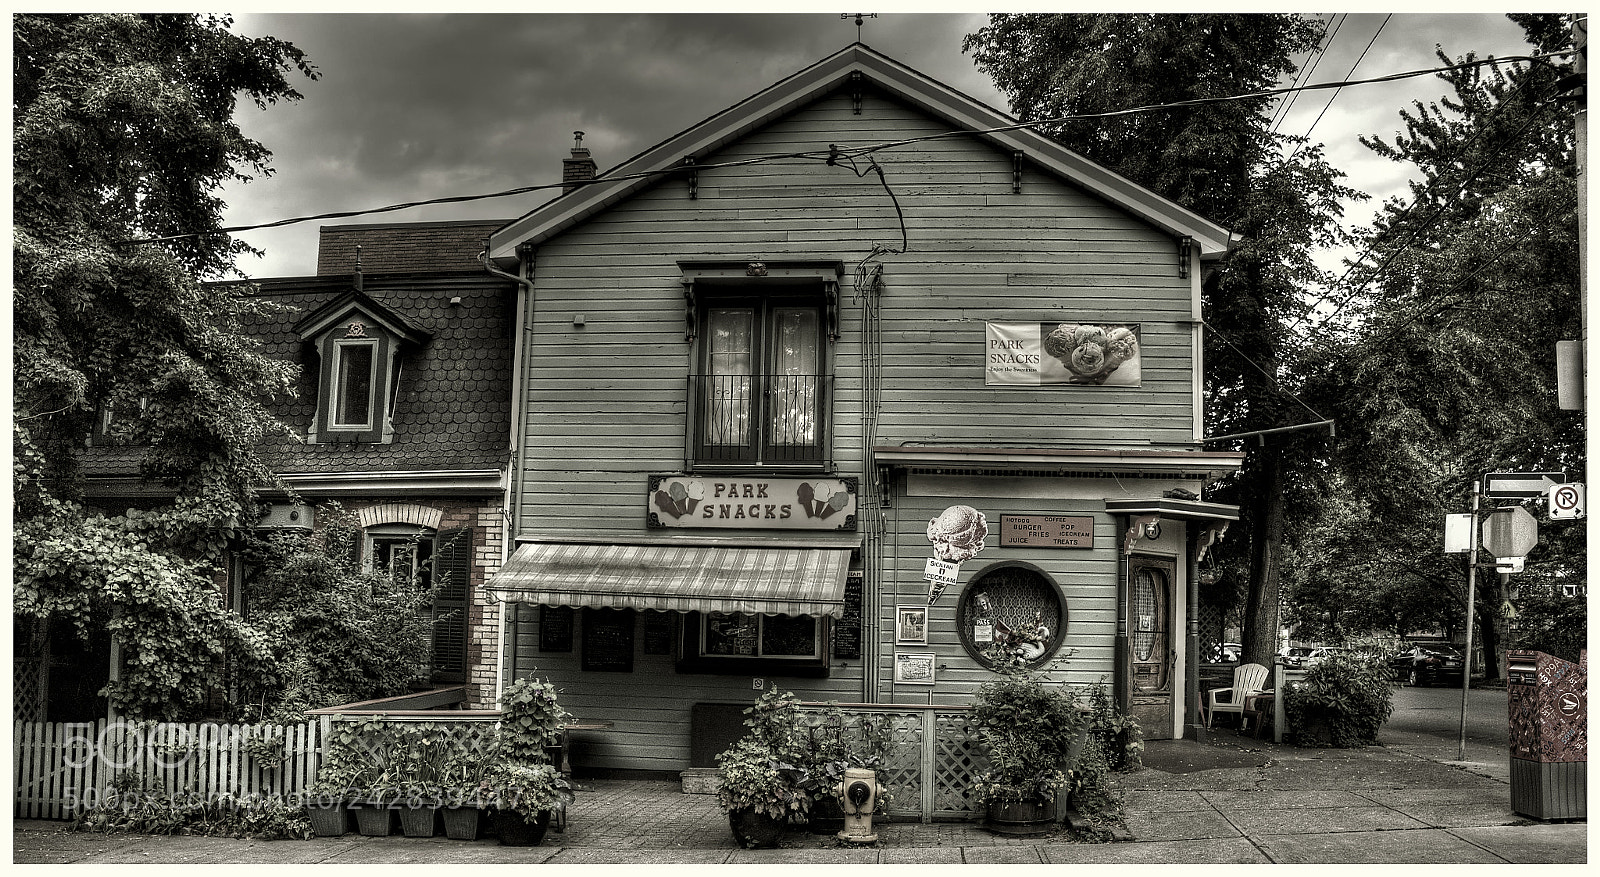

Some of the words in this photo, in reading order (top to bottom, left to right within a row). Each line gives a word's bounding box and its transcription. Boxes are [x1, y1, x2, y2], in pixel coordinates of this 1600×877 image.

[990, 339, 1024, 350] PARK
[990, 353, 1040, 364] SNACKS
[714, 483, 769, 498] PARK
[702, 503, 792, 519] SNACKS
[1052, 538, 1078, 546] TREATS
